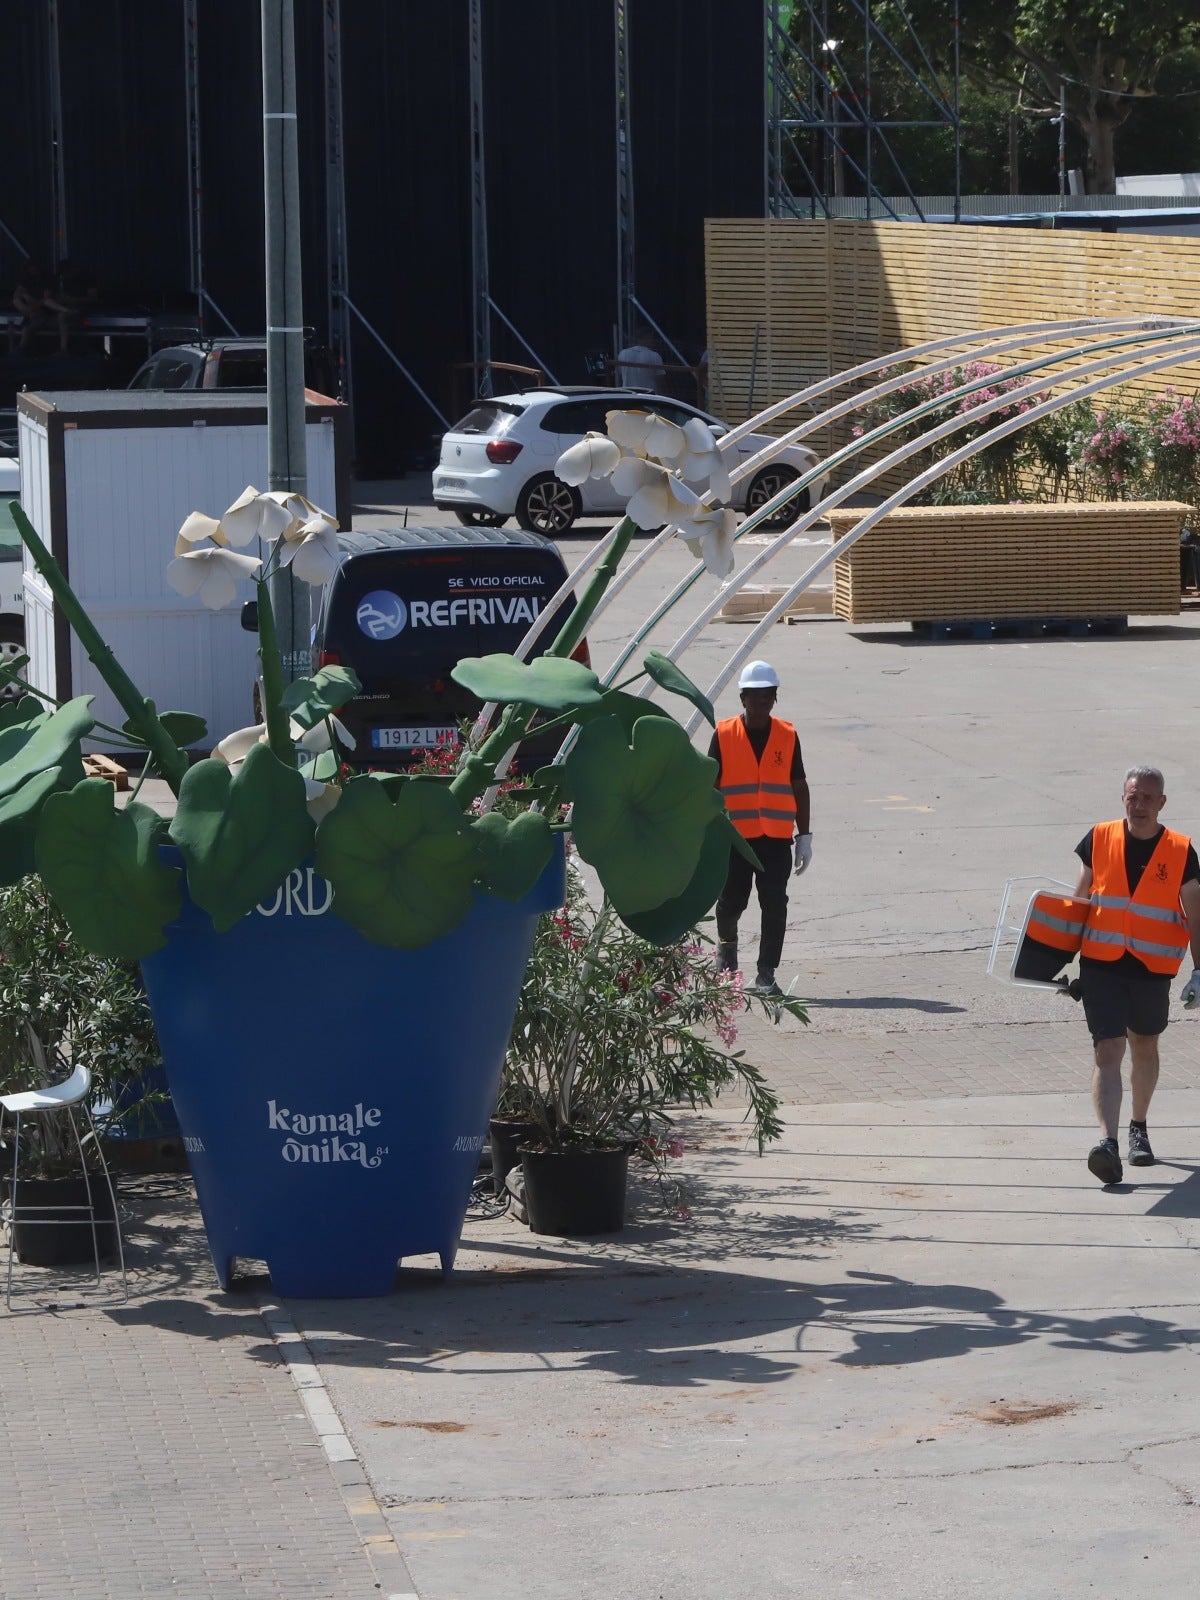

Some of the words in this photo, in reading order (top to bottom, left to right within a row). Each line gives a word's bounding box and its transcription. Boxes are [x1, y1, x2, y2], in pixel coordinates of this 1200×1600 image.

[503, 576, 545, 586] OFICIAL
[410, 597, 541, 628] REFRIVAL
[384, 730, 421, 745] 1912
[267, 1099, 382, 1136] kamale
